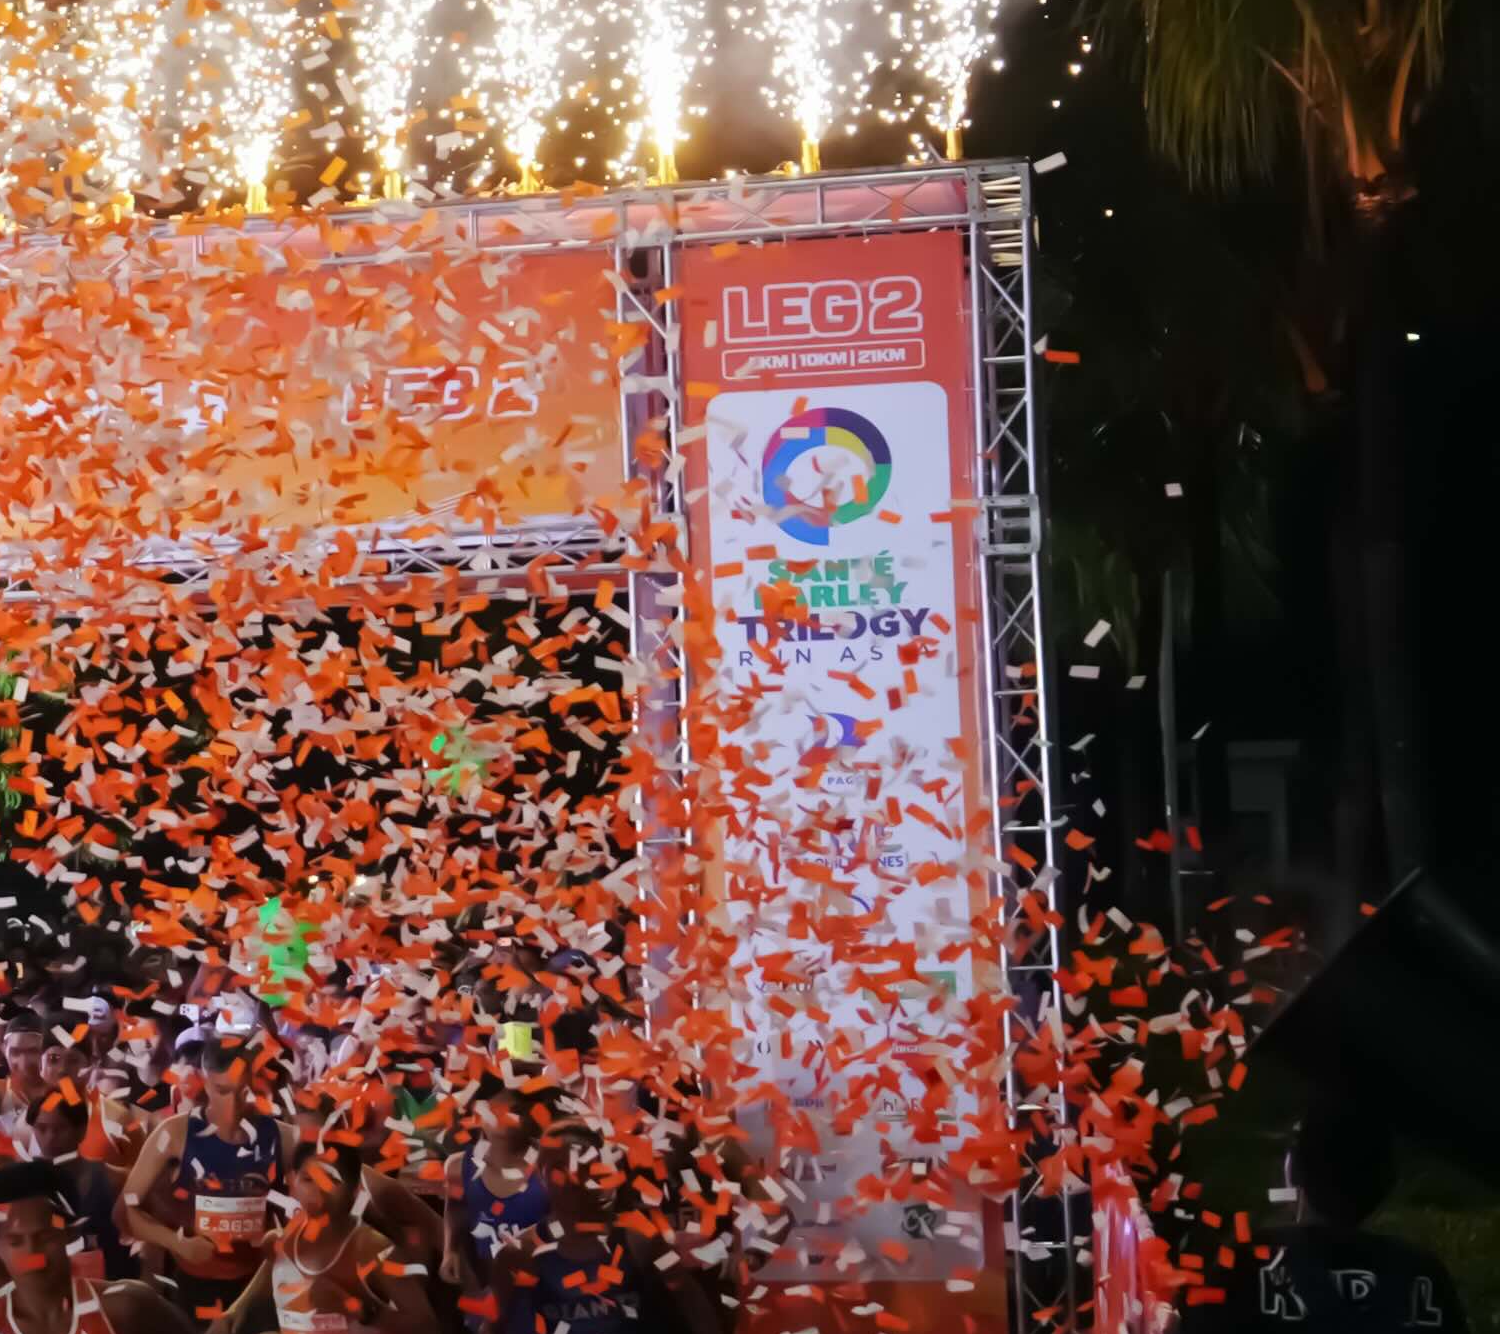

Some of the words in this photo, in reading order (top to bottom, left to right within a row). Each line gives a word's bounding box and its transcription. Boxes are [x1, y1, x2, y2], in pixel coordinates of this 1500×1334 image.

[723, 280, 863, 343] LEG
[869, 276, 924, 334] 2
[800, 351, 847, 367] 10KM
[858, 348, 906, 364] 21KM
[754, 581, 908, 610] RLEY
[739, 648, 812, 666] RN
